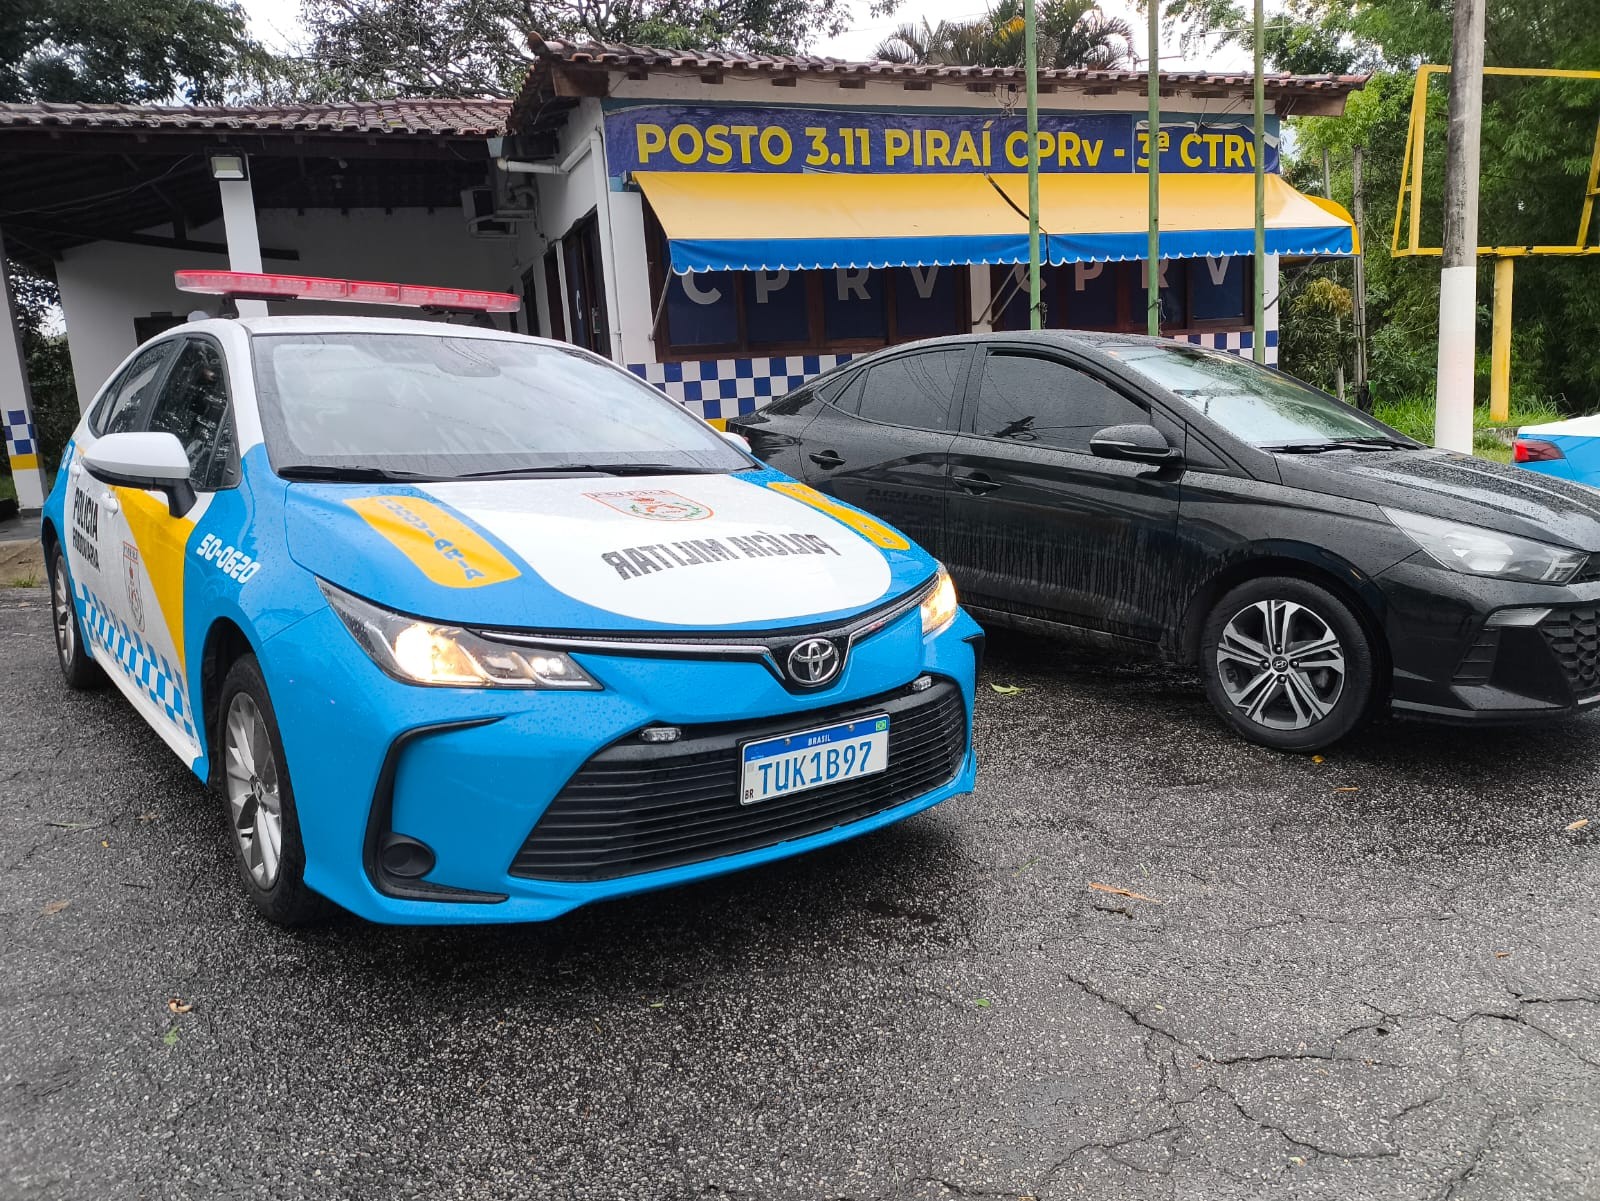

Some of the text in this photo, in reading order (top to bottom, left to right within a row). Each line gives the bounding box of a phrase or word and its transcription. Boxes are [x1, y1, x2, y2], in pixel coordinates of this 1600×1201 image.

[636, 124, 792, 165] POSTO
[805, 127, 871, 166] 3.11
[885, 120, 994, 167] PIRAÍ
[1005, 130, 1104, 167] CPRv
[73, 486, 99, 542] POLÍCIA
[196, 533, 262, 583] 50-0620
[807, 734, 831, 746] BRASIL
[758, 740, 872, 795] TUK1B97
[744, 788, 754, 800] BR
